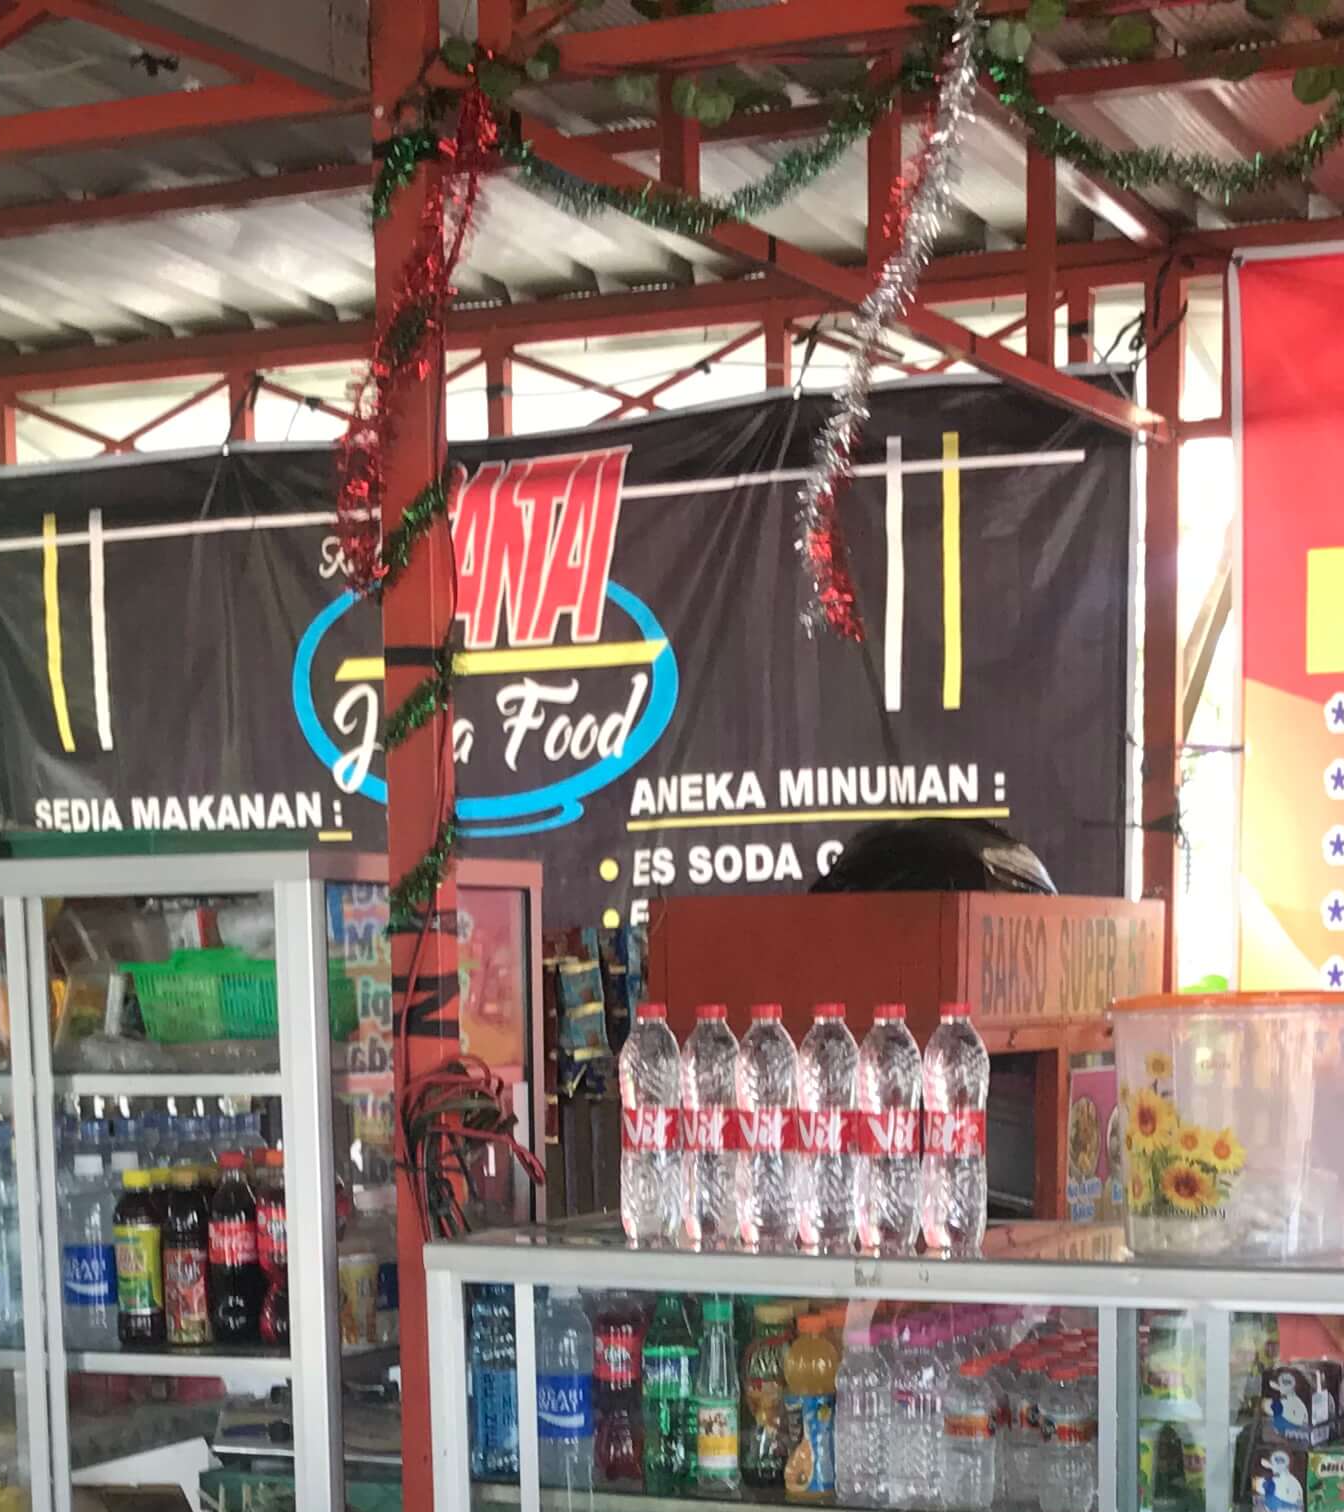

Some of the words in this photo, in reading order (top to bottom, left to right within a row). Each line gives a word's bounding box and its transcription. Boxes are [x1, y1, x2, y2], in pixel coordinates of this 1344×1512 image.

[451, 445, 632, 650] ANTAI
[495, 672, 649, 772] Food
[34, 797, 119, 833] SEDIA
[131, 791, 323, 831] MAKANAN
[630, 771, 766, 816] ANEKA
[779, 764, 979, 809] MINUMAN
[632, 847, 676, 887] ES
[688, 842, 803, 884] SODA
